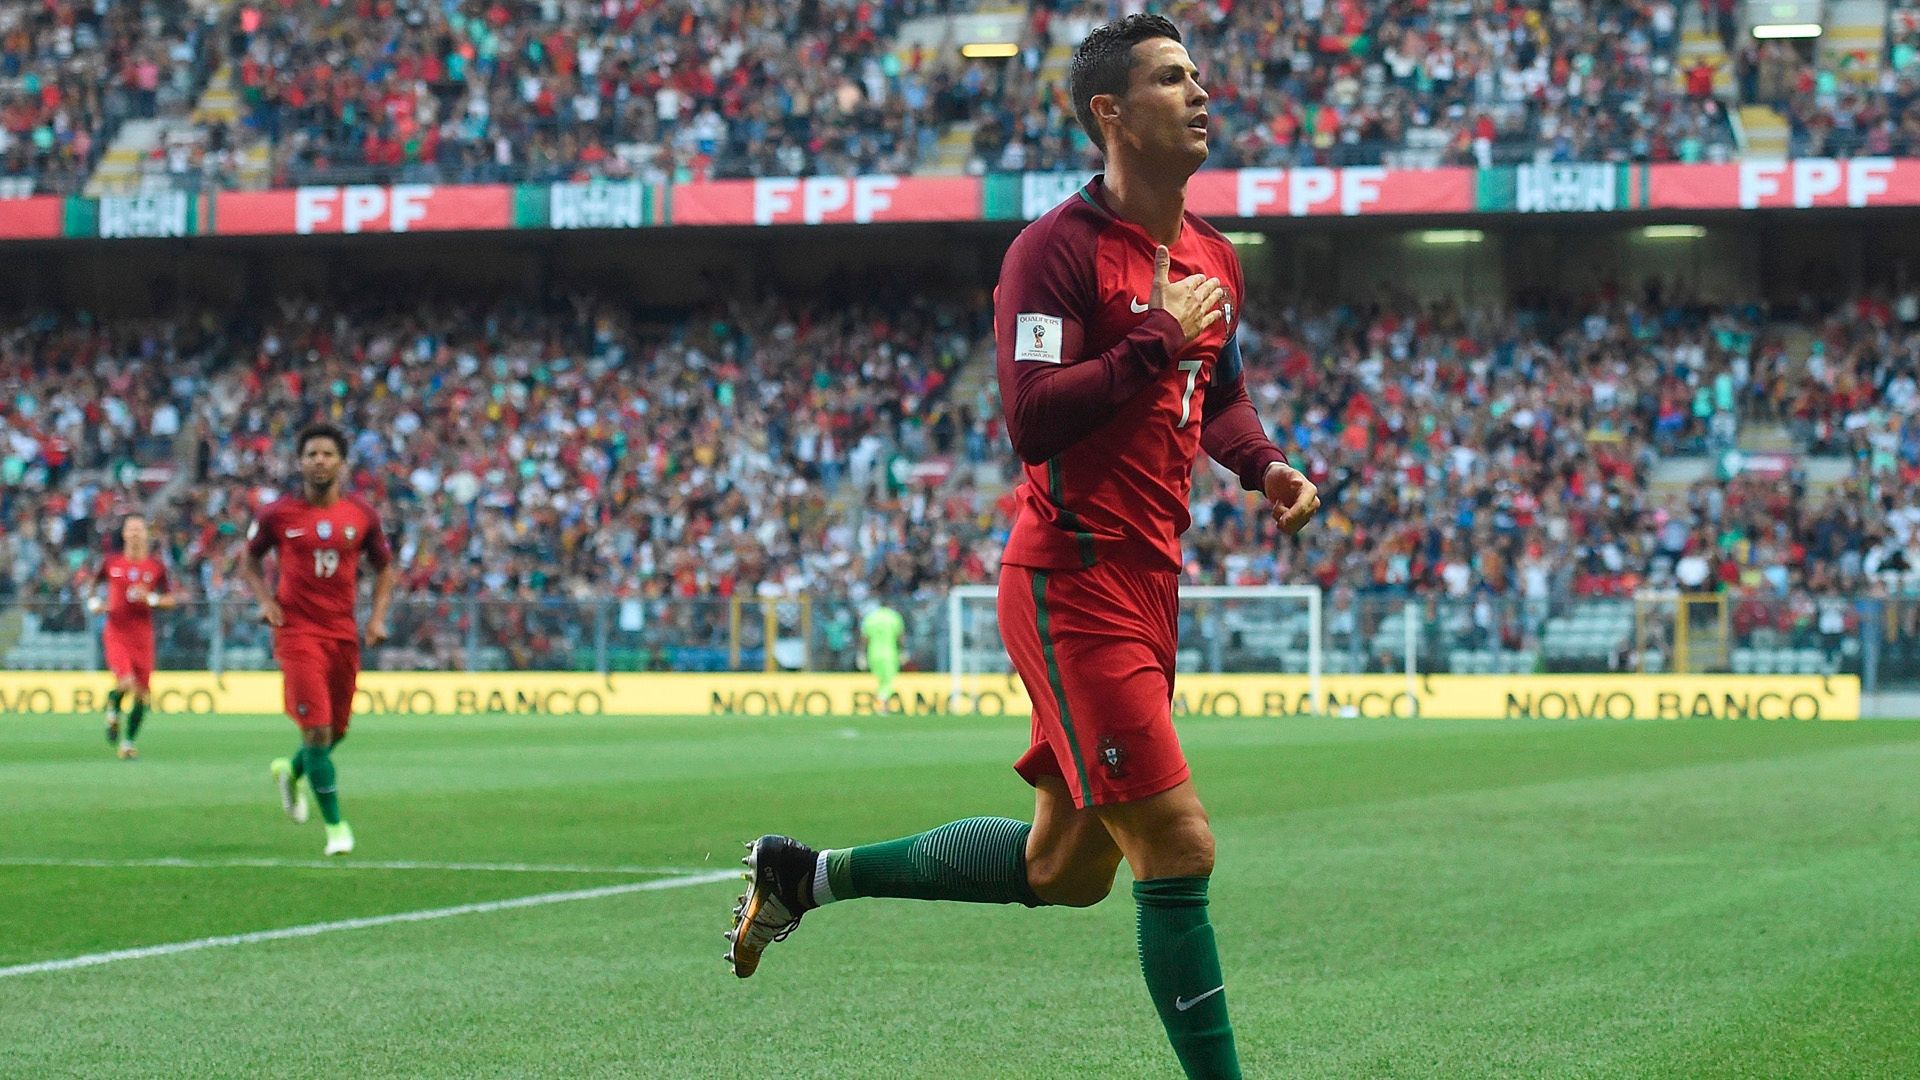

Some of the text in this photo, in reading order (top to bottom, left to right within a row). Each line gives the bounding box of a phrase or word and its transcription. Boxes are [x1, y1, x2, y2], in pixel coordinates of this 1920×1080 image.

[1237, 167, 1386, 217] FPF
[1739, 157, 1897, 210] FPF
[295, 186, 434, 234] FPF
[754, 177, 899, 226] FPF
[1177, 360, 1203, 428] 7
[313, 549, 339, 578] 19
[0, 689, 214, 714] VO BCO
[351, 689, 603, 715] OVO BANCO
[711, 691, 831, 716] NOVO
[1174, 692, 1241, 717] VO
[1506, 692, 1819, 720] NOVO BANCO
